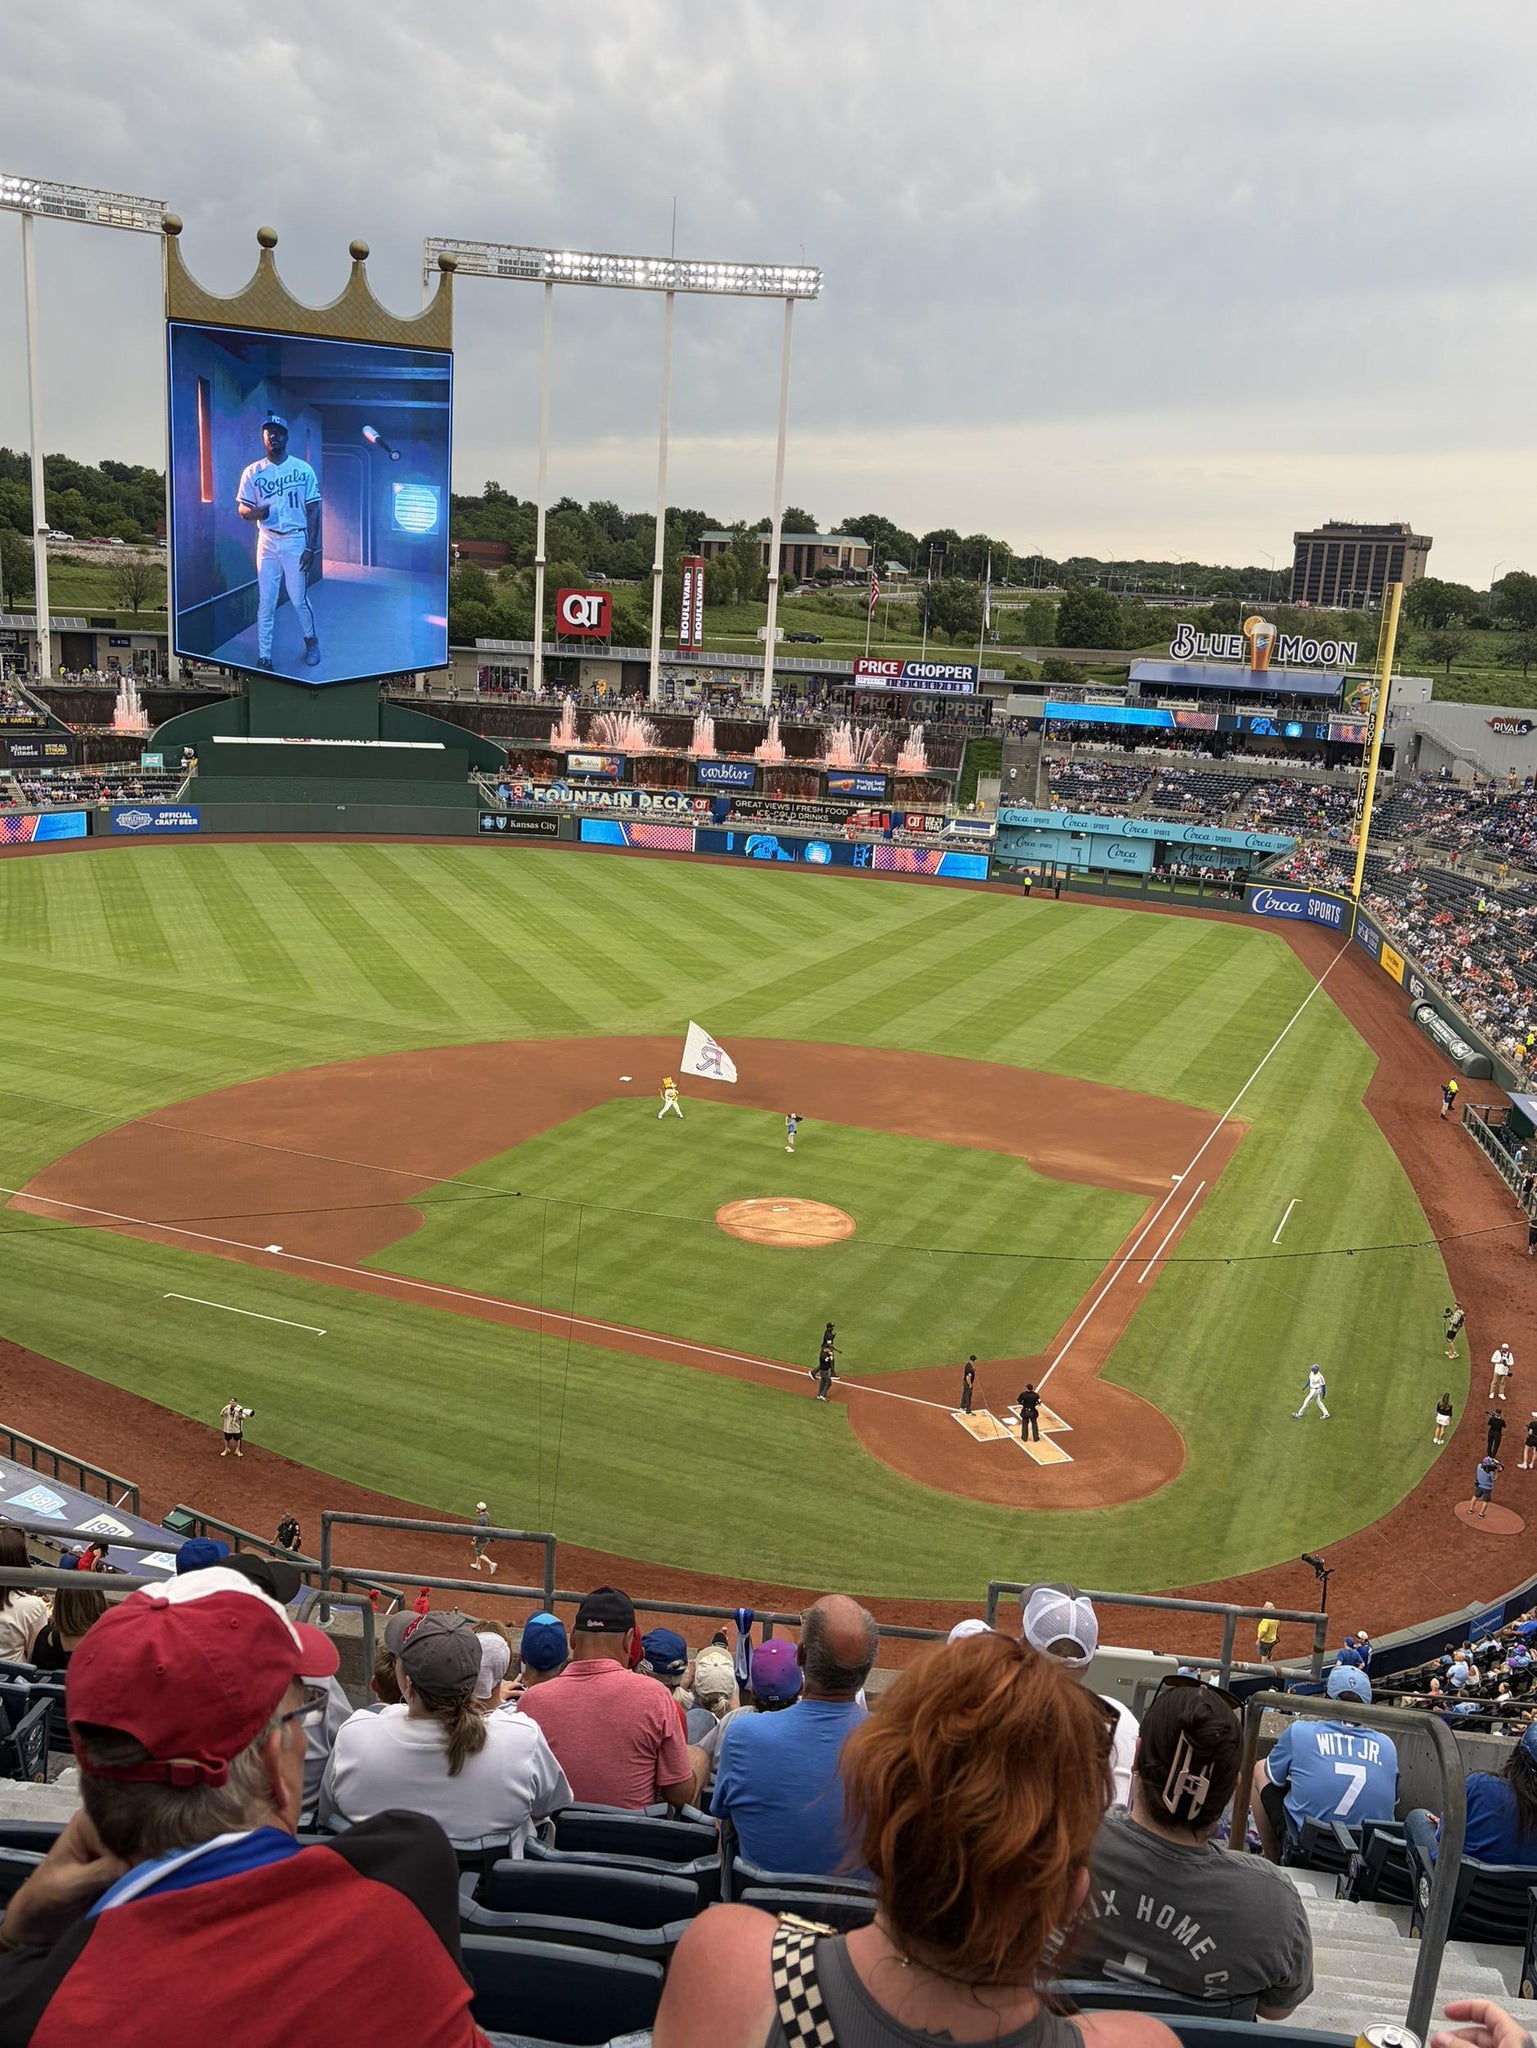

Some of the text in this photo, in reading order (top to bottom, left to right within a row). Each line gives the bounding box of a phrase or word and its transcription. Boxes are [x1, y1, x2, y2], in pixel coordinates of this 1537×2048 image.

[254, 468, 306, 498] Royals
[287, 491, 299, 508] 11
[562, 594, 603, 628] QT
[680, 572, 692, 639] BOULEVARD
[694, 573, 703, 640] BOULEVARD
[1170, 623, 1358, 666] BLUE MOON
[859, 660, 972, 680] PRICE CHOPPER
[1493, 722, 1528, 734] RIVALS
[10, 744, 33, 753] planet
[701, 764, 751, 780] carbliss
[534, 787, 690, 810] FOUNTAIN DECK
[695, 800, 707, 809] QT
[159, 811, 191, 819] OFFICIAL
[735, 800, 849, 815] GREAT VIEWS FRESH FOOD
[757, 809, 829, 822] ICE-COLD DRINKS
[155, 818, 178, 826] CRAFT
[510, 820, 556, 831] Kansas City
[908, 815, 921, 828] QT
[1003, 810, 1050, 825] Circa SPORTS
[1062, 814, 1110, 831] Circa SPORTS
[1122, 820, 1171, 837] Circa SPORTS
[1183, 827, 1233, 843] Circa SPORTS
[1016, 836, 1036, 847] Circa
[1245, 834, 1273, 848] Circa
[1108, 843, 1137, 859] Circa
[1180, 846, 1214, 862] Circa
[1252, 889, 1342, 924] Circa SPORTS
[19, 1489, 61, 1511] 1980
[1315, 1732, 1383, 1767] WITT JR.
[1333, 1762, 1367, 1816] 7
[1136, 1894, 1217, 1961] HOME
